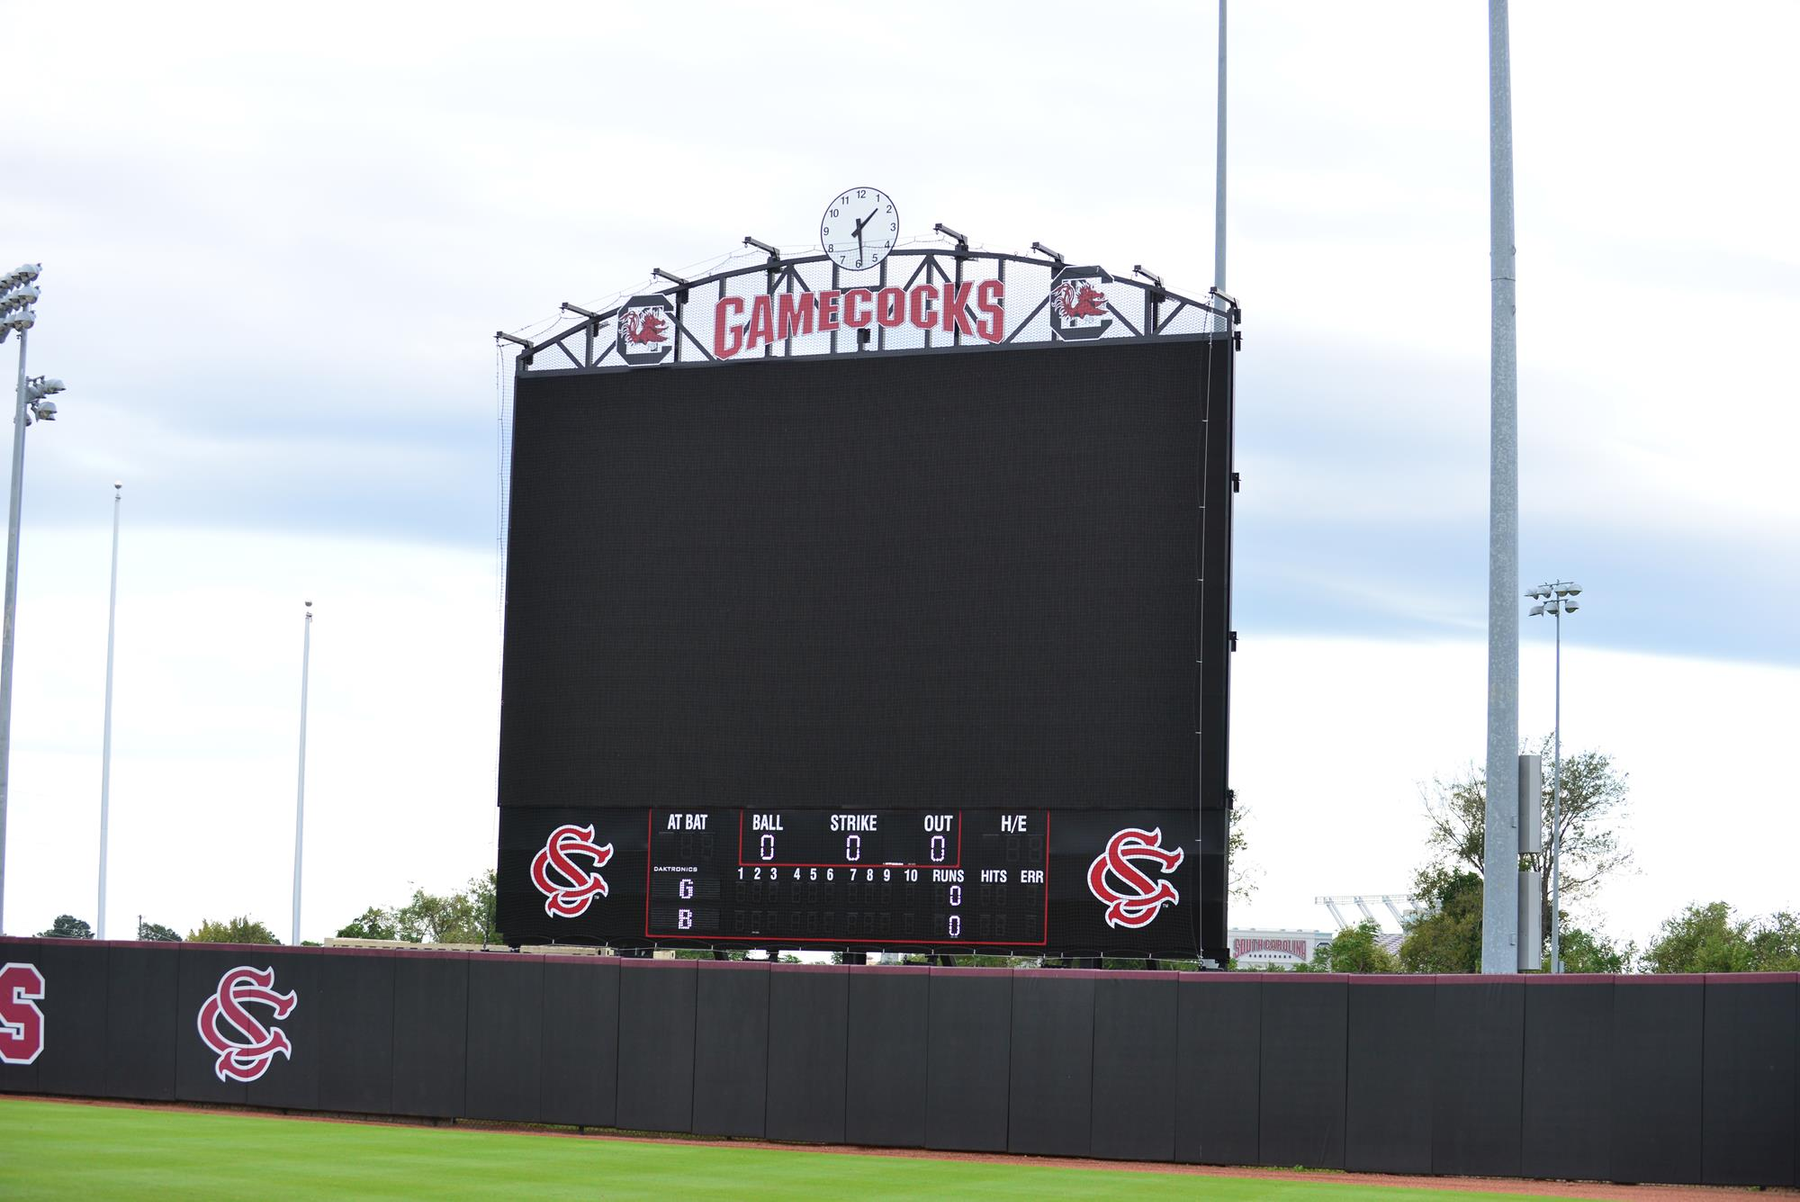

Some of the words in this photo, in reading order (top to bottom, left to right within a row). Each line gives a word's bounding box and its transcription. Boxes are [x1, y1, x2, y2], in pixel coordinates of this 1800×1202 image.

[841, 196, 849, 205] 11
[857, 190, 867, 199] 12
[876, 194, 880, 202] 1
[829, 209, 839, 218] 10
[886, 205, 892, 214] 2
[823, 227, 829, 236] 9
[890, 223, 896, 232] 3
[828, 244, 834, 253] 8
[884, 240, 890, 249] 4
[840, 256, 846, 264] 7
[855, 259, 862, 269] 6
[872, 254, 878, 263] 5
[714, 279, 1004, 361] GAMECOCKS
[667, 814, 682, 830] AT
[685, 814, 708, 830] BAT
[752, 814, 783, 831] BALL
[830, 814, 877, 831] STRIKE
[924, 815, 953, 832] OUT
[1001, 815, 1027, 833] H/E
[760, 834, 775, 860] 0
[846, 835, 861, 861] 0
[930, 835, 945, 862] 0
[738, 867, 744, 880] 1
[753, 867, 761, 880] 2
[770, 867, 778, 880] 3
[793, 868, 801, 881] 4
[810, 868, 817, 881] 5
[826, 868, 834, 881] 6
[849, 868, 857, 881] 7
[866, 868, 874, 882] 8
[883, 868, 891, 882] 9
[904, 869, 918, 882] 10
[932, 869, 965, 883] RUNS
[981, 869, 1008, 883] HITS
[1020, 870, 1044, 884] ERR
[679, 878, 694, 899] G
[949, 885, 961, 906] 0
[678, 909, 693, 930] B
[948, 915, 960, 936] 0
[1233, 938, 1263, 959] SOUTH
[1264, 939, 1307, 961] CAROLINA
